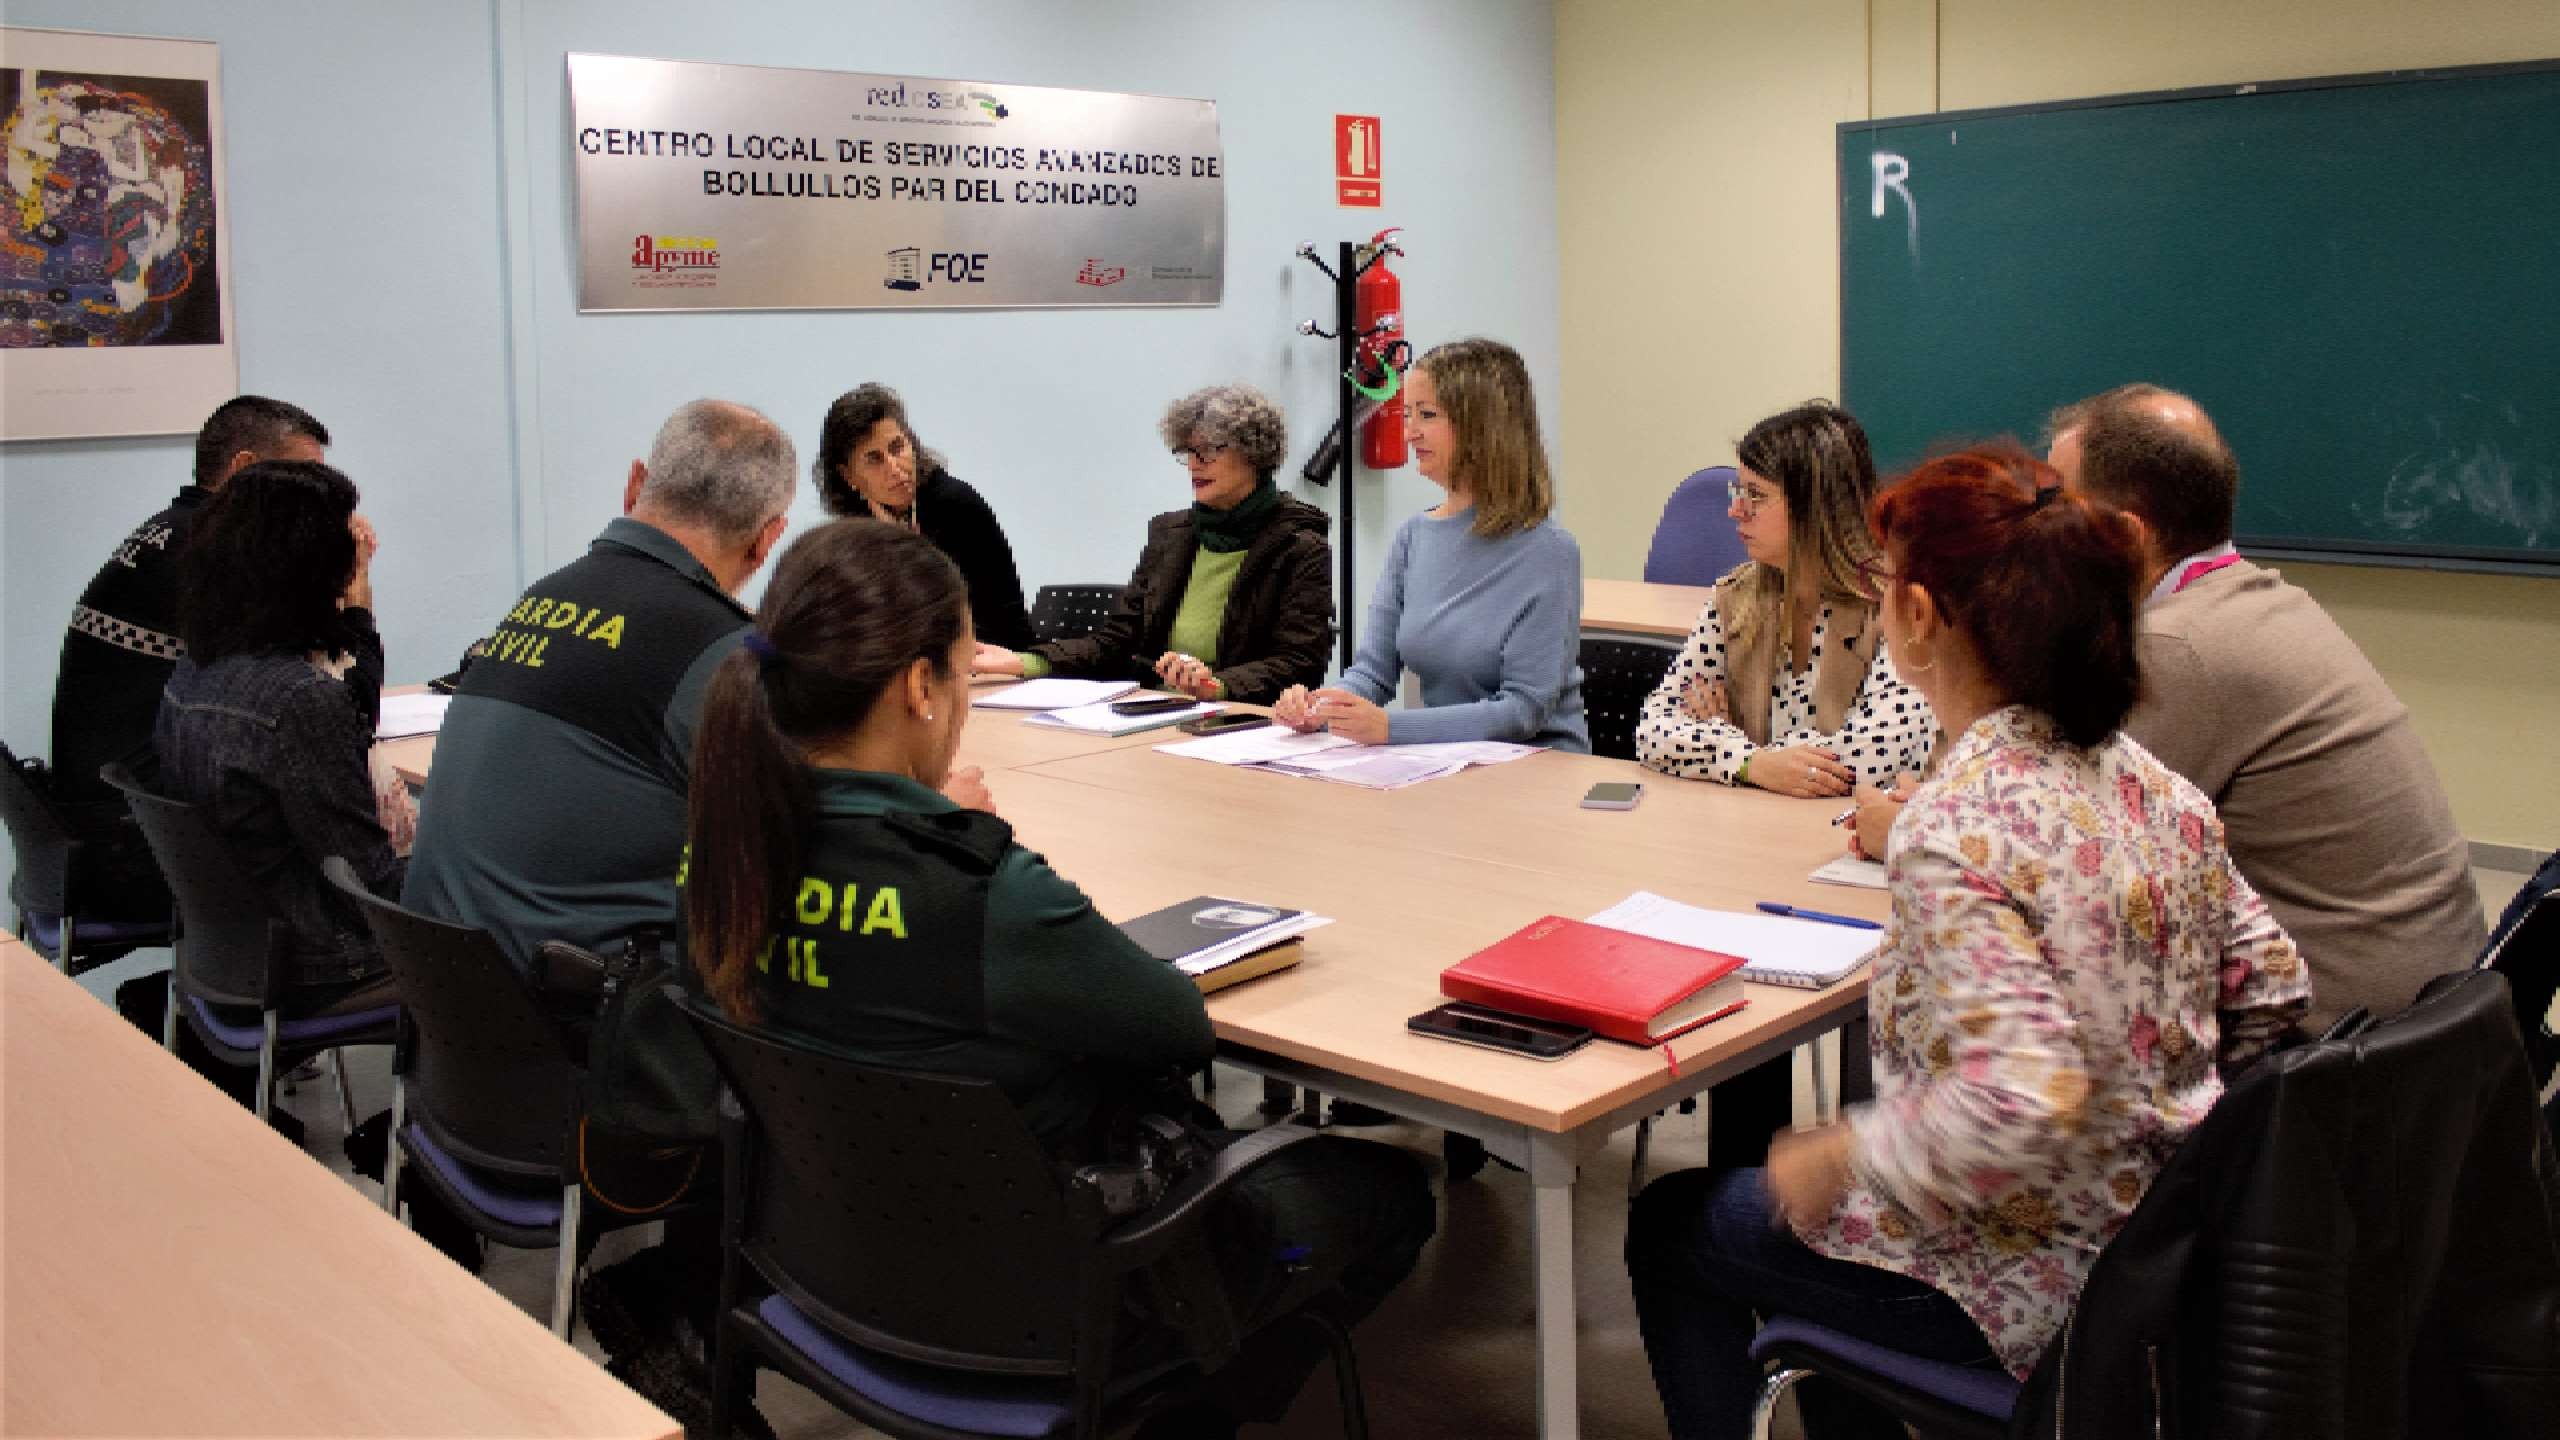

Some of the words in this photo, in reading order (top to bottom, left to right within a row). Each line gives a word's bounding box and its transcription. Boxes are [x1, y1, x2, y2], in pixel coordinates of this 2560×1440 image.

[580, 127, 717, 158] CENTRO
[727, 133, 828, 162] LOCAL
[836, 139, 877, 165] DE
[884, 142, 1027, 169] SERVICIOS
[1036, 150, 1181, 176] AVANZADOS
[1191, 156, 1221, 178] DE
[704, 169, 881, 199] BOLLULLOS
[891, 176, 945, 201] PAR
[956, 179, 1004, 203] DEL
[1015, 181, 1137, 206] CONDADO
[928, 253, 989, 283] FOE
[506, 597, 625, 649] ARDIA
